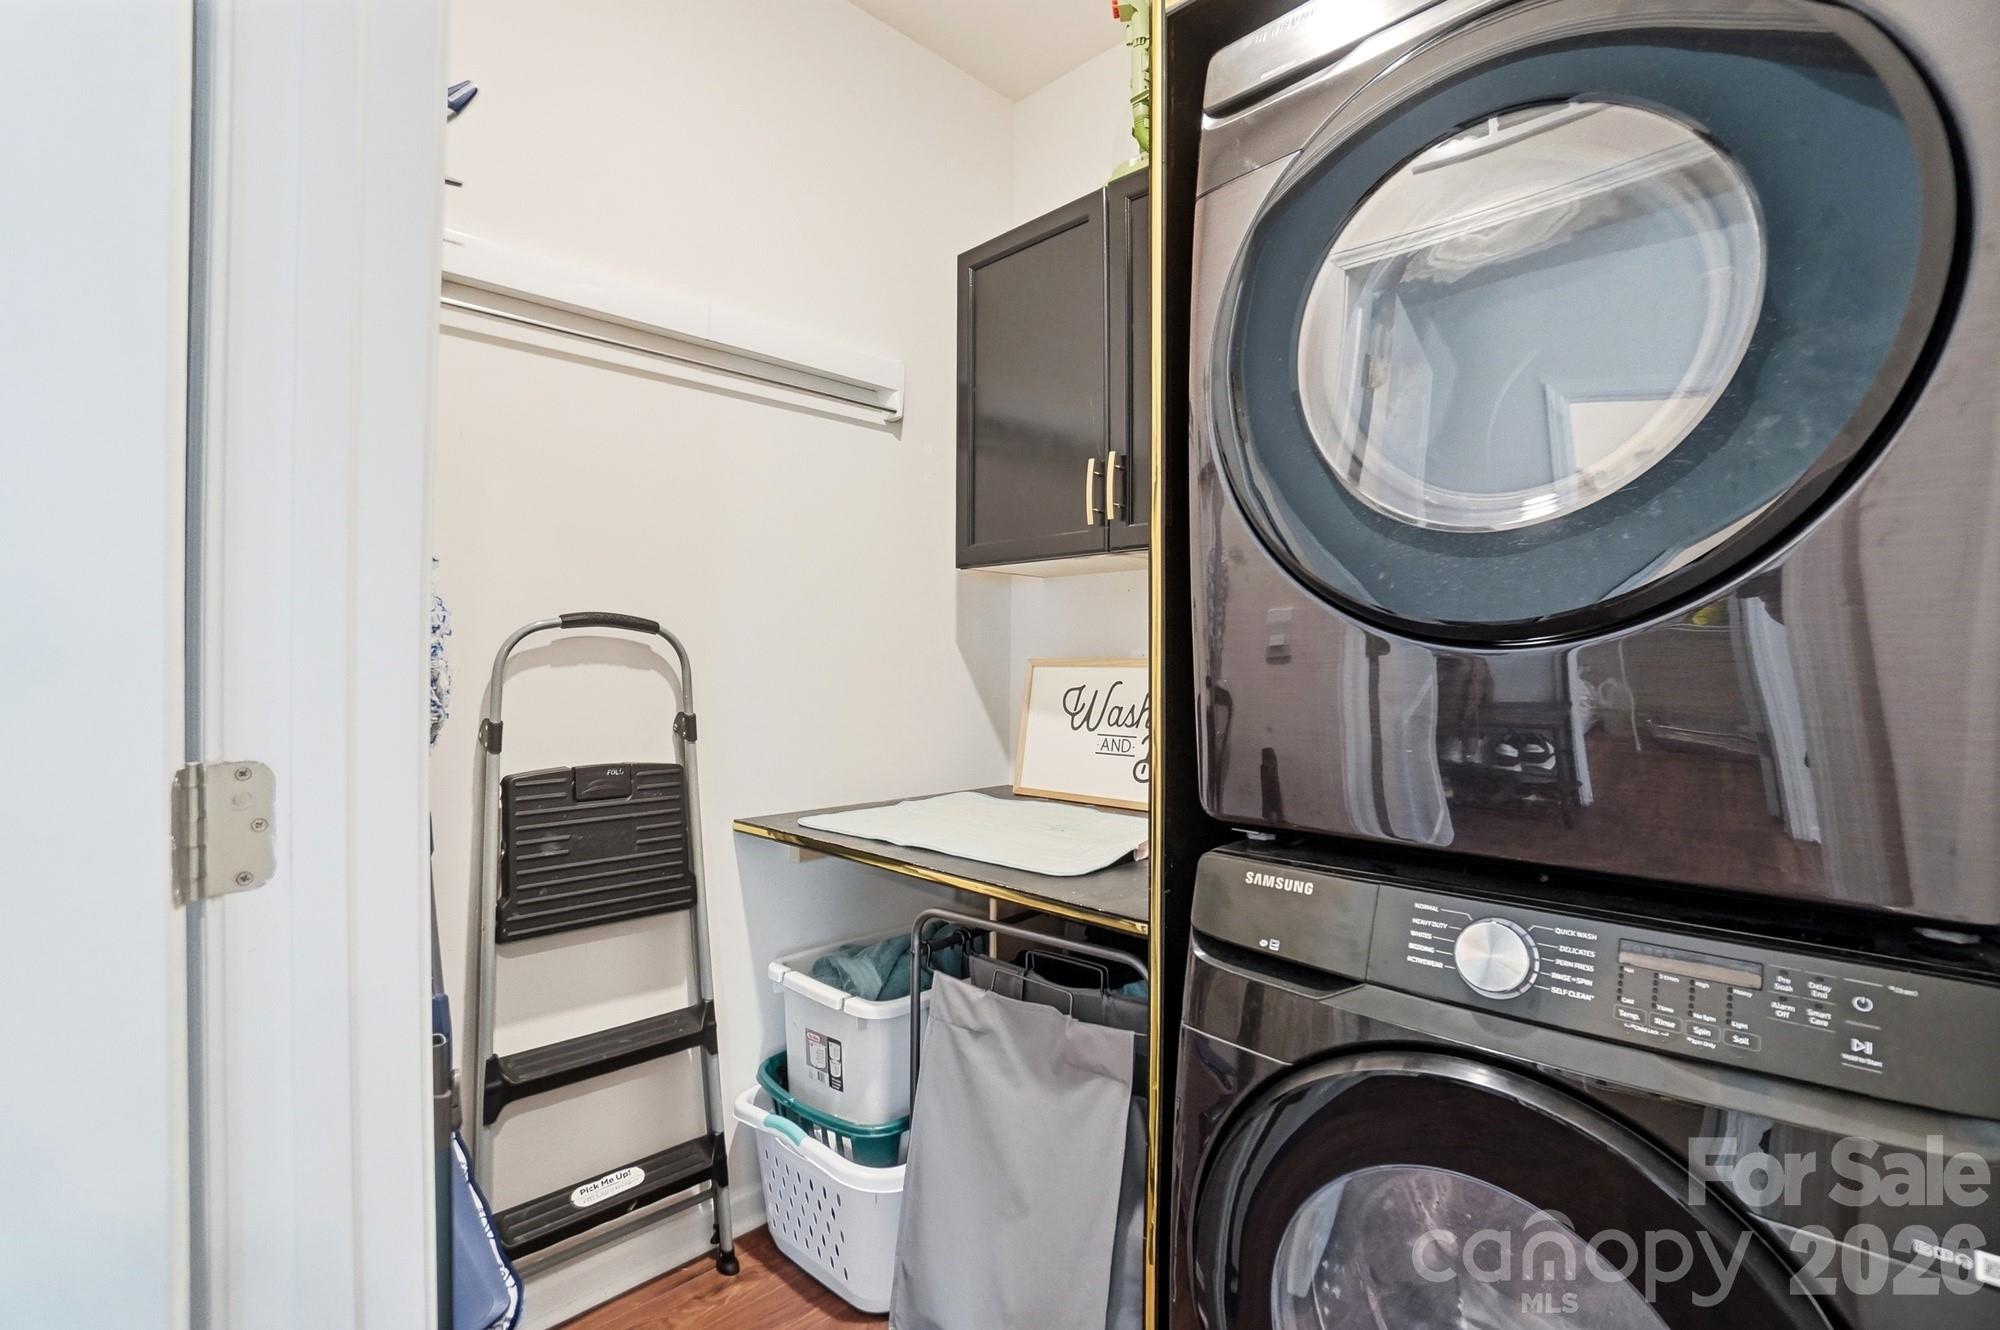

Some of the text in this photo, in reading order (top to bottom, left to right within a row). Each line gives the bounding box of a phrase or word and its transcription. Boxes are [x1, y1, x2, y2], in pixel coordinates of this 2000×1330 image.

[1063, 681, 1149, 731] Wash
[1100, 738, 1132, 753] AND
[1245, 871, 1314, 895] SAMSUNG
[1414, 902, 1439, 912] NORMAL
[1412, 918, 1432, 926] HEAVY
[1555, 927, 1598, 940] QUICK WASH
[1559, 945, 1596, 958] DELICATES
[1555, 958, 1595, 972] PERM PRESS
[1551, 972, 1572, 982] RINSE
[1576, 977, 1593, 986] SPIN
[1551, 986, 1568, 996] SELF
[1774, 982, 1794, 993] Soak
[1807, 981, 1833, 994] Delay
[1810, 989, 1828, 1000] End
[1771, 1001, 1796, 1013] Alarm
[1775, 1010, 1790, 1019] Off
[1806, 1008, 1832, 1020] Smart
[1654, 1017, 1676, 1029] Rinse
[1692, 1025, 1712, 1038] Spin
[1732, 1034, 1750, 1046] Soil
[580, 1184, 599, 1195] Pick
[615, 1170, 632, 1180] Up!
